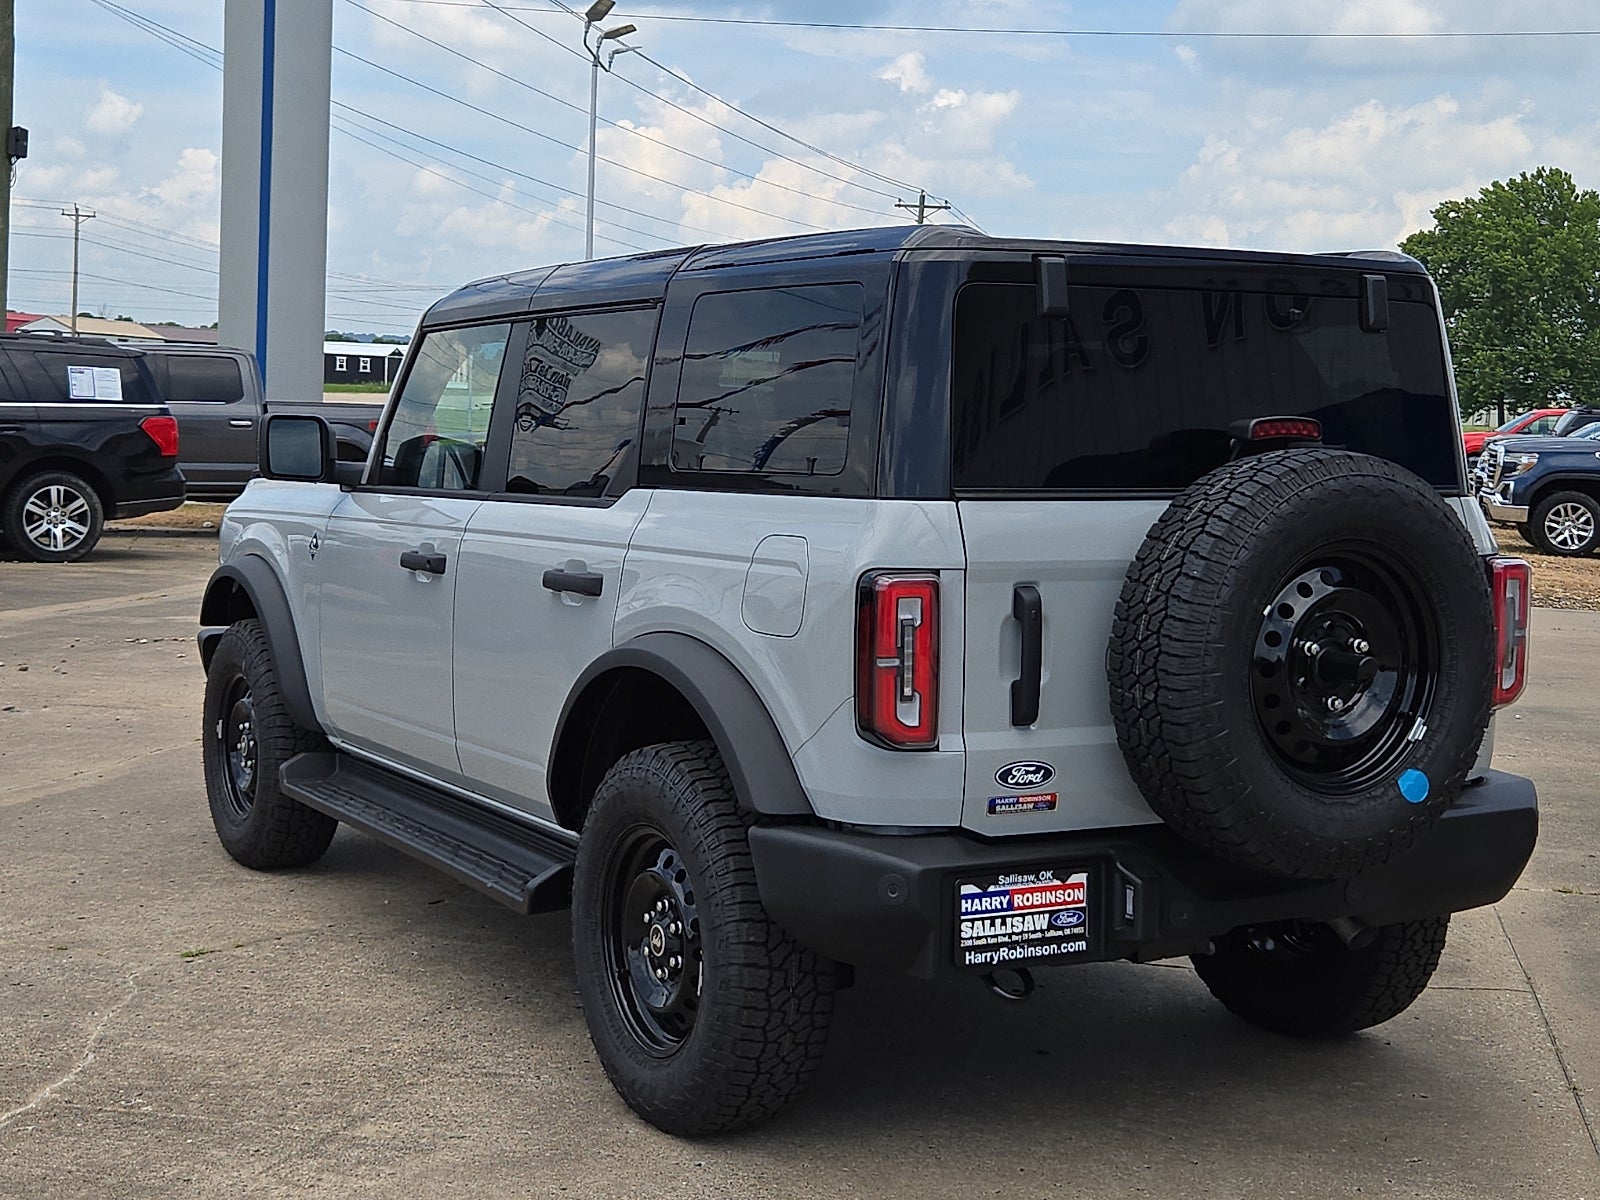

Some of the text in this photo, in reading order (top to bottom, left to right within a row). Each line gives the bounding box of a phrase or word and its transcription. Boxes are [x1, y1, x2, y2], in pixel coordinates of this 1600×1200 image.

[1008, 766, 1045, 784] Ford
[995, 794, 1052, 805] HARRY ROBINSON
[995, 802, 1035, 813] SALLISAW
[998, 873, 1037, 885] Sallisaw,
[1039, 870, 1054, 880] OK
[961, 888, 1084, 912] HARRY ROBINSON
[961, 911, 1079, 938] SALLISAW Ford
[965, 940, 1087, 965] HarryRobinson.com
